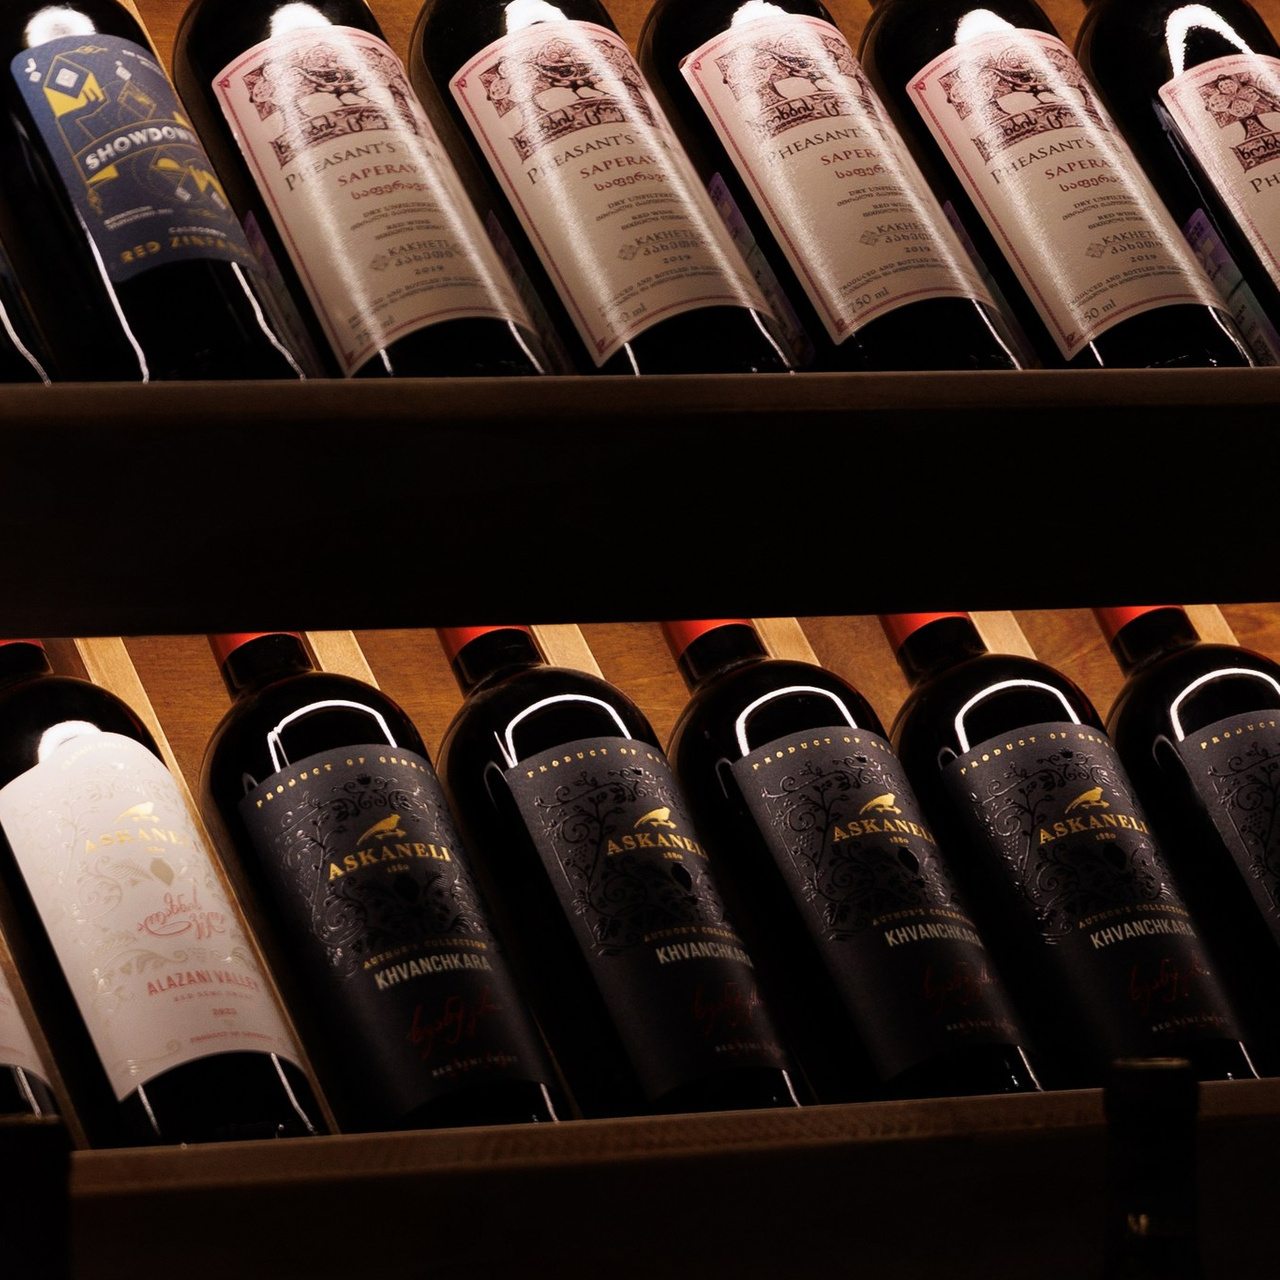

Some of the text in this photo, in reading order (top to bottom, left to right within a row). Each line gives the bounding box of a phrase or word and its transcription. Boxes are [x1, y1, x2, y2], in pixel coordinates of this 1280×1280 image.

[84, 125, 201, 171] SHOWDOWN
[337, 163, 422, 187] SAPERAV
[579, 154, 660, 180] SAPERAV
[1044, 158, 1111, 180] SAPERA
[848, 187, 867, 196] DRY
[607, 198, 626, 208] DRY
[872, 202, 890, 210] RED
[1073, 199, 1092, 209] DRY
[631, 212, 650, 220] RED
[387, 239, 450, 256] KAKHETI
[635, 229, 696, 246] KAKHETI
[120, 241, 162, 264] RED
[663, 255, 692, 265] 2019
[904, 245, 932, 254] 2019
[1130, 253, 1158, 263] 2019
[414, 264, 445, 275] 2019
[879, 262, 895, 272] AND
[1105, 273, 1121, 285] AND
[1121, 265, 1156, 280] BOTTLED
[847, 286, 890, 313] 750 ml
[1082, 299, 1117, 324] 50 ml
[1200, 720, 1276, 750] PRODUCT
[527, 746, 638, 778] PRODUCT OF
[752, 736, 861, 771] PRODUCT OF
[960, 731, 1069, 775] PRODUCT OF
[255, 756, 367, 809] PRODUCT OF
[889, 835, 910, 844] 1880
[1038, 813, 1150, 845] ASKANELI
[1095, 832, 1117, 841] 1880
[327, 843, 452, 880] ASKANELI
[872, 908, 926, 926] AUTHOR'S
[1079, 905, 1132, 930] AUTHOR'S
[643, 926, 699, 943] AUTHOR'S
[1089, 918, 1198, 951] KHVANCHKARA
[363, 944, 419, 970] AUTHOR'S
[374, 952, 493, 991] KHVANCHKARA
[147, 970, 260, 996] ALAZANI VALLEY
